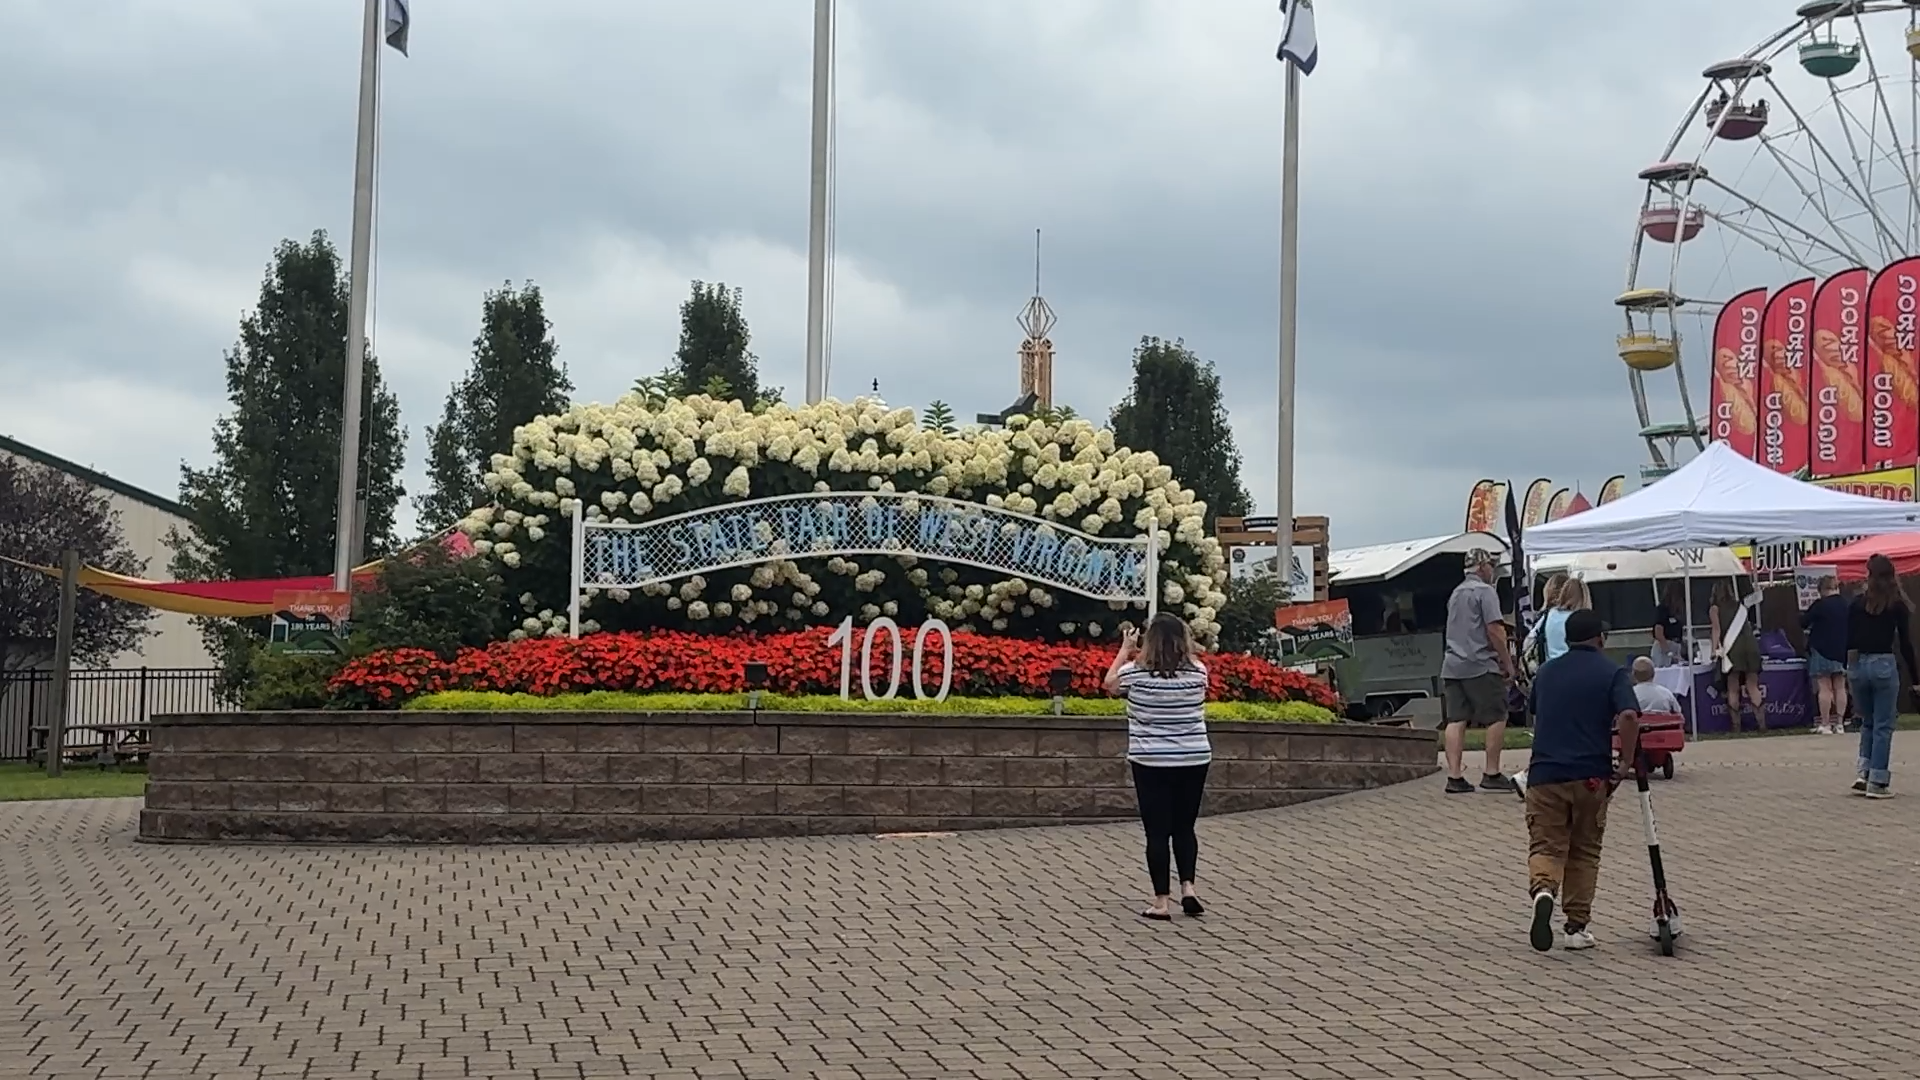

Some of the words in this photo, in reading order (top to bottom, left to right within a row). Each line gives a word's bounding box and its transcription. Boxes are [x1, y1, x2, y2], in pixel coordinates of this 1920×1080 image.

[591, 536, 651, 576] THE
[668, 511, 768, 565] STATE
[782, 503, 849, 547] FAIR
[866, 504, 898, 541] OF
[919, 506, 1000, 555] WEST
[1015, 526, 1141, 588] VIRGINIA
[317, 604, 333, 612] YOU
[1317, 613, 1333, 622] YOU
[1310, 630, 1334, 640] YEARS
[827, 615, 953, 702] 100
